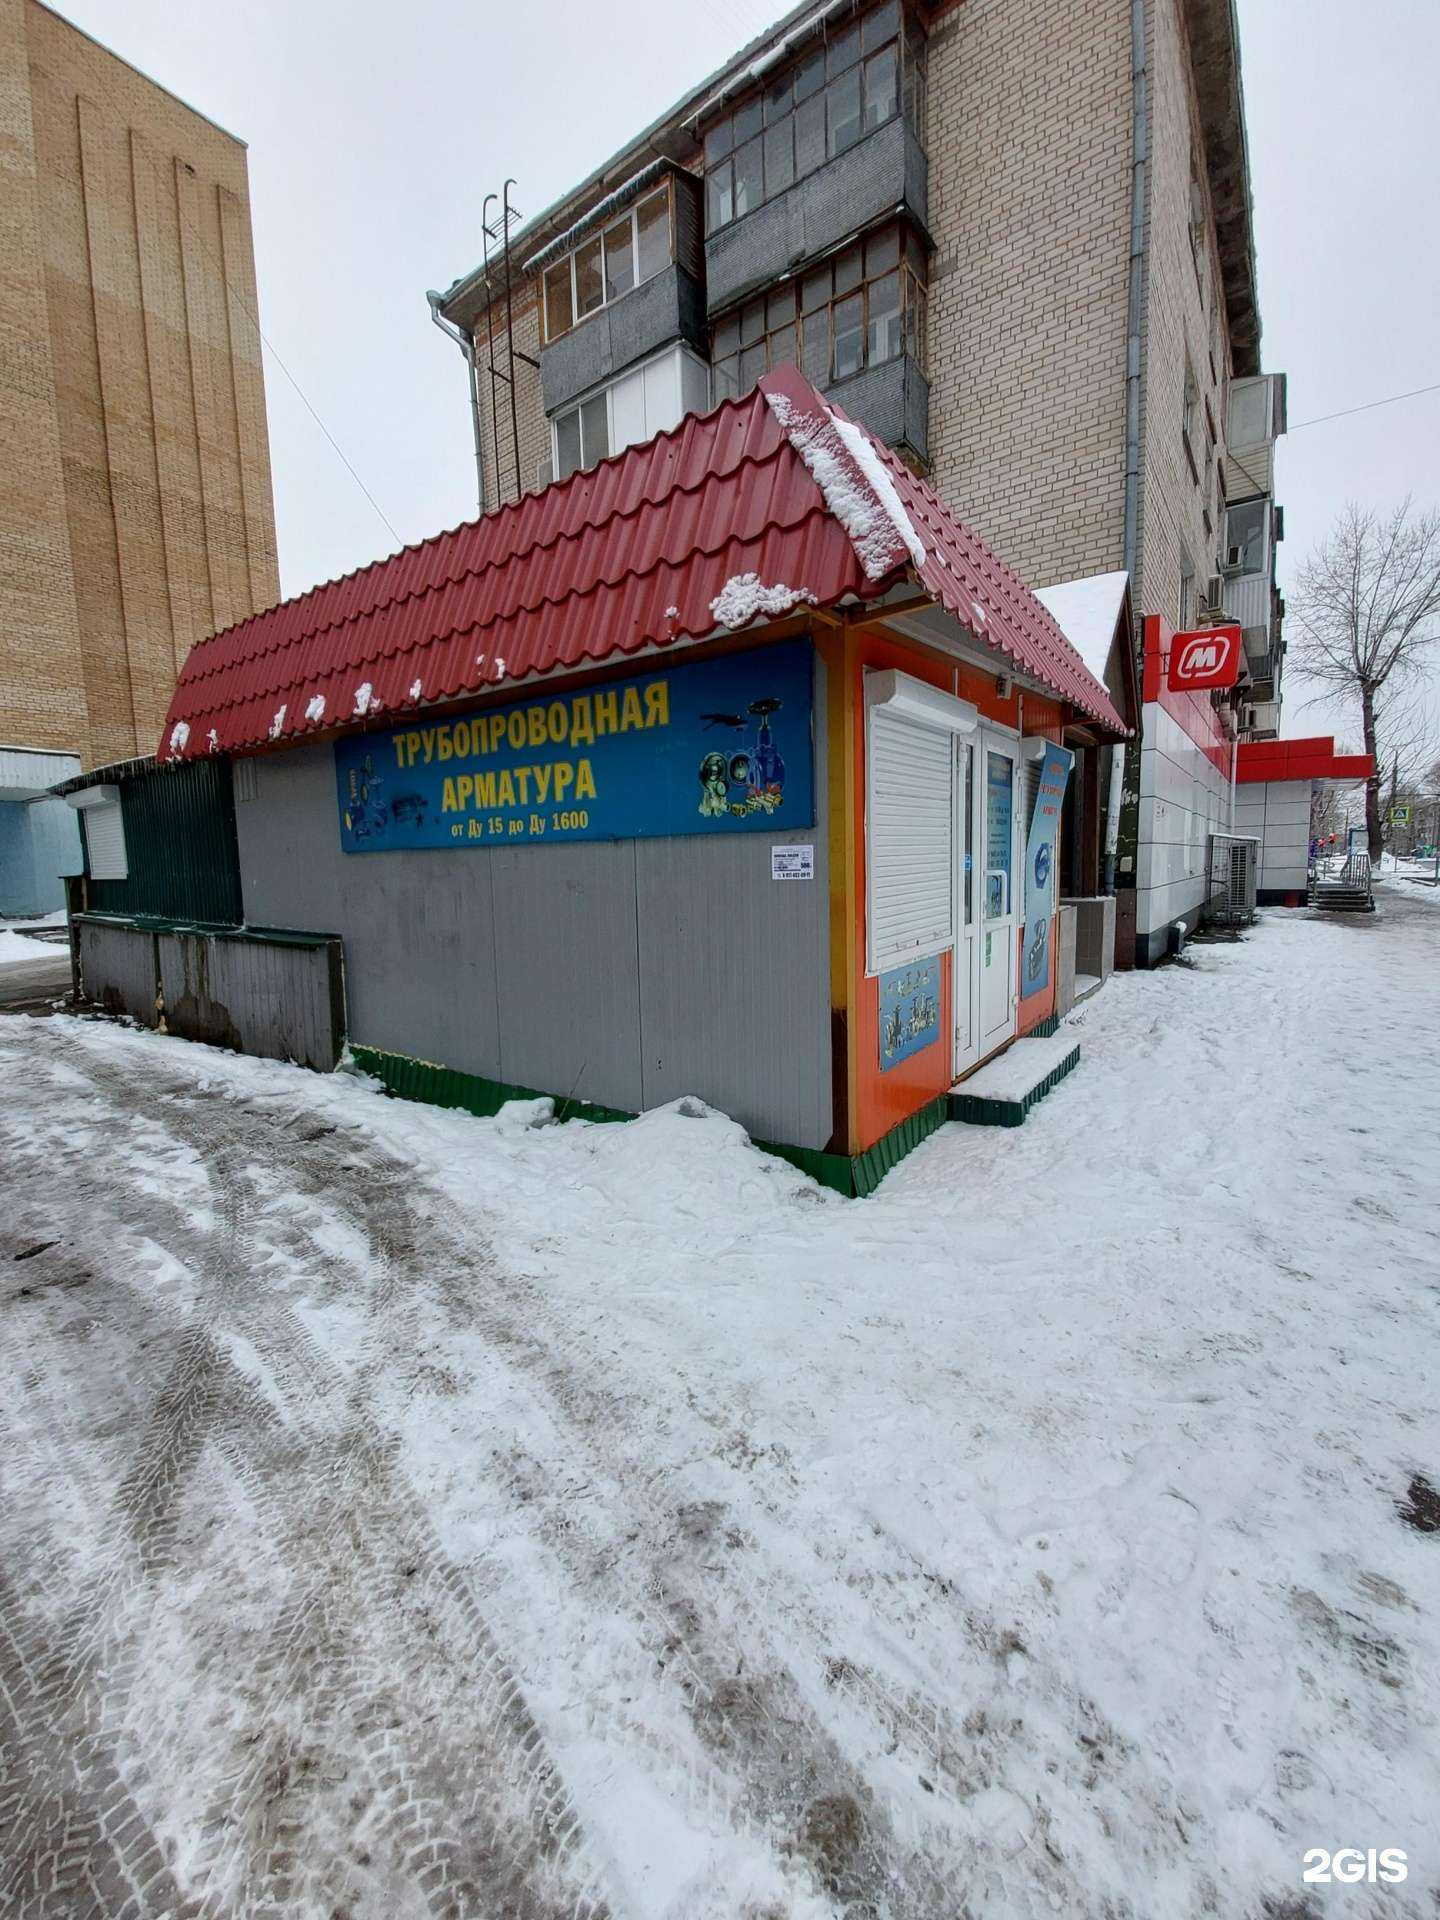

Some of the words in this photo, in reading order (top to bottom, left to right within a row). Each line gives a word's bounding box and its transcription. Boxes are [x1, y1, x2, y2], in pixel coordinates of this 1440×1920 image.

[393, 680, 669, 768] ТРУБОПРОВОДНАЯ
[441, 758, 597, 813] АРМАТУРА
[451, 824, 464, 837] от
[468, 818, 482, 838] Ду
[488, 816, 503, 834] 15
[508, 819, 524, 835] до
[529, 814, 546, 835] Ду
[552, 810, 589, 830] 1600
